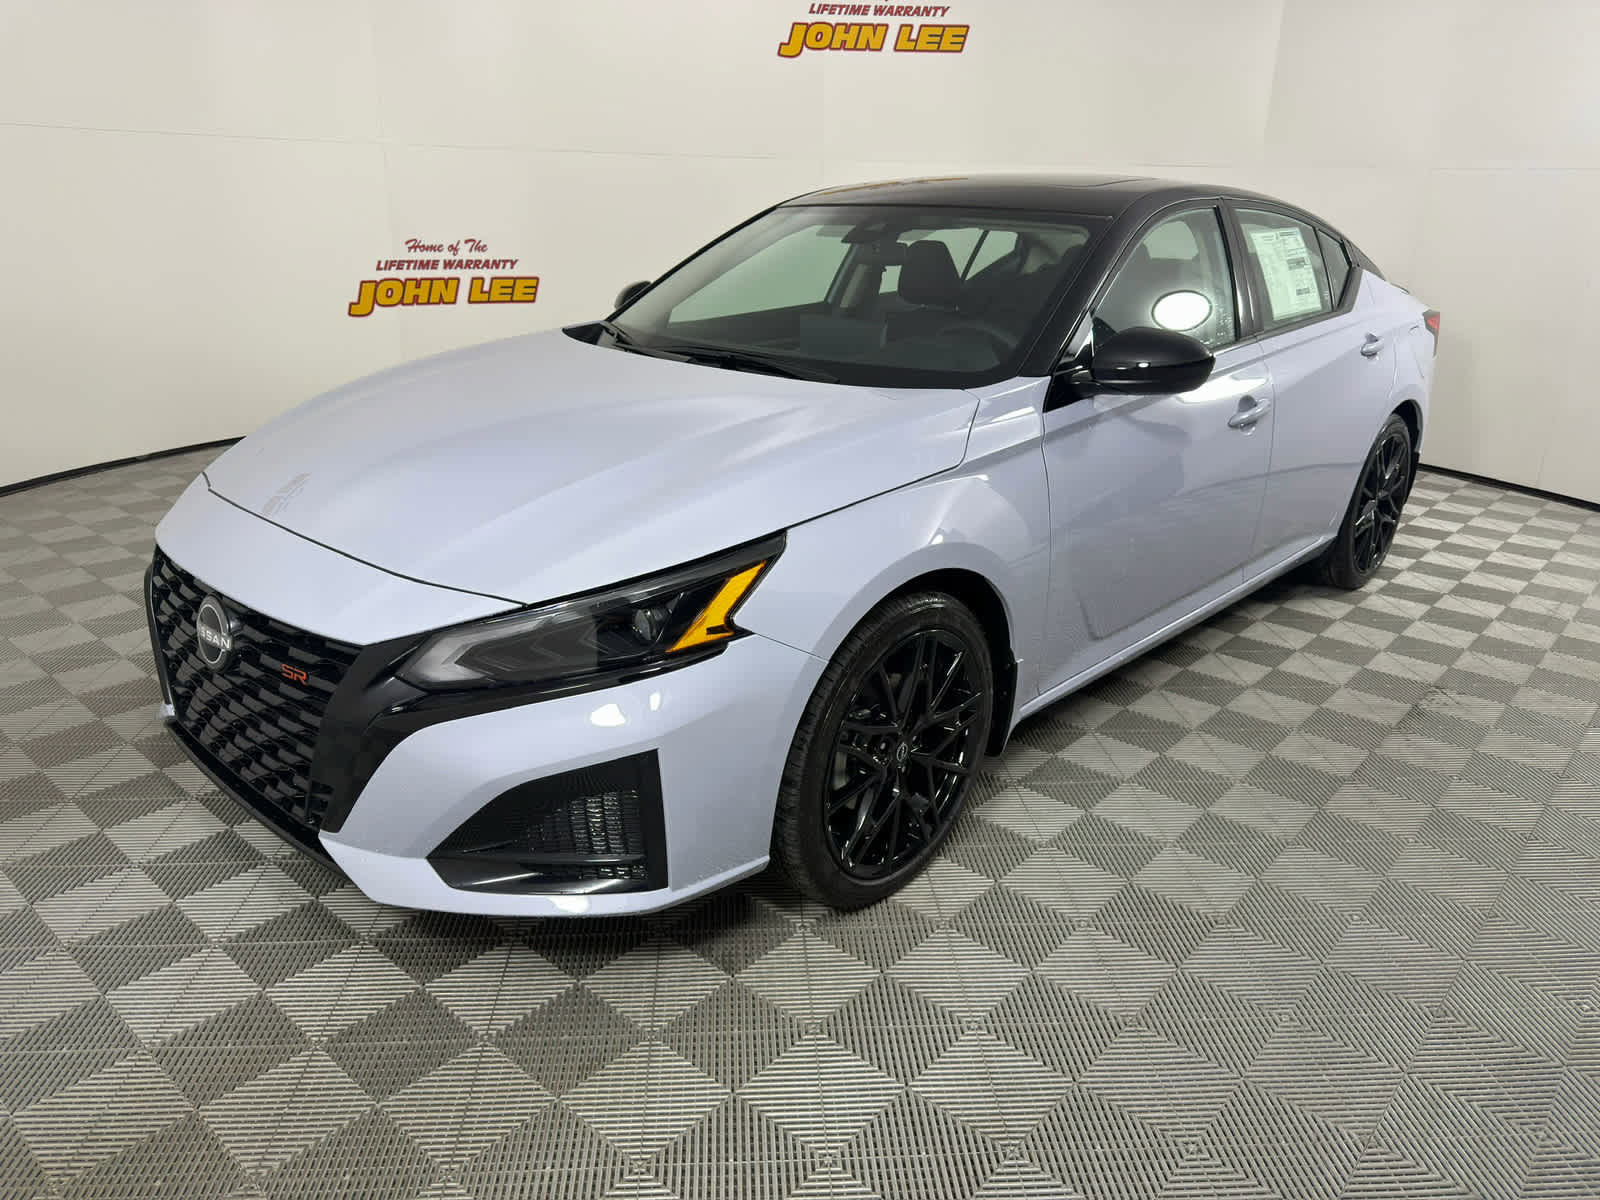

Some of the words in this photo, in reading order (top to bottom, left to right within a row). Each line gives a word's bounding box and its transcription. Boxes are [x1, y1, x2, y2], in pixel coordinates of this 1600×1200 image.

[808, 3, 871, 16] LIFETIME
[873, 5, 950, 17] WARRANTY
[778, 22, 888, 57] JOHN
[894, 24, 969, 52] LEE
[404, 238, 445, 253] Home
[447, 240, 461, 256] of
[464, 238, 488, 253] The
[376, 259, 440, 271] LIFETIME
[442, 259, 519, 270] WARRANTY
[348, 276, 460, 317] JOHN
[467, 276, 540, 304] LEE
[281, 663, 307, 686] SR
